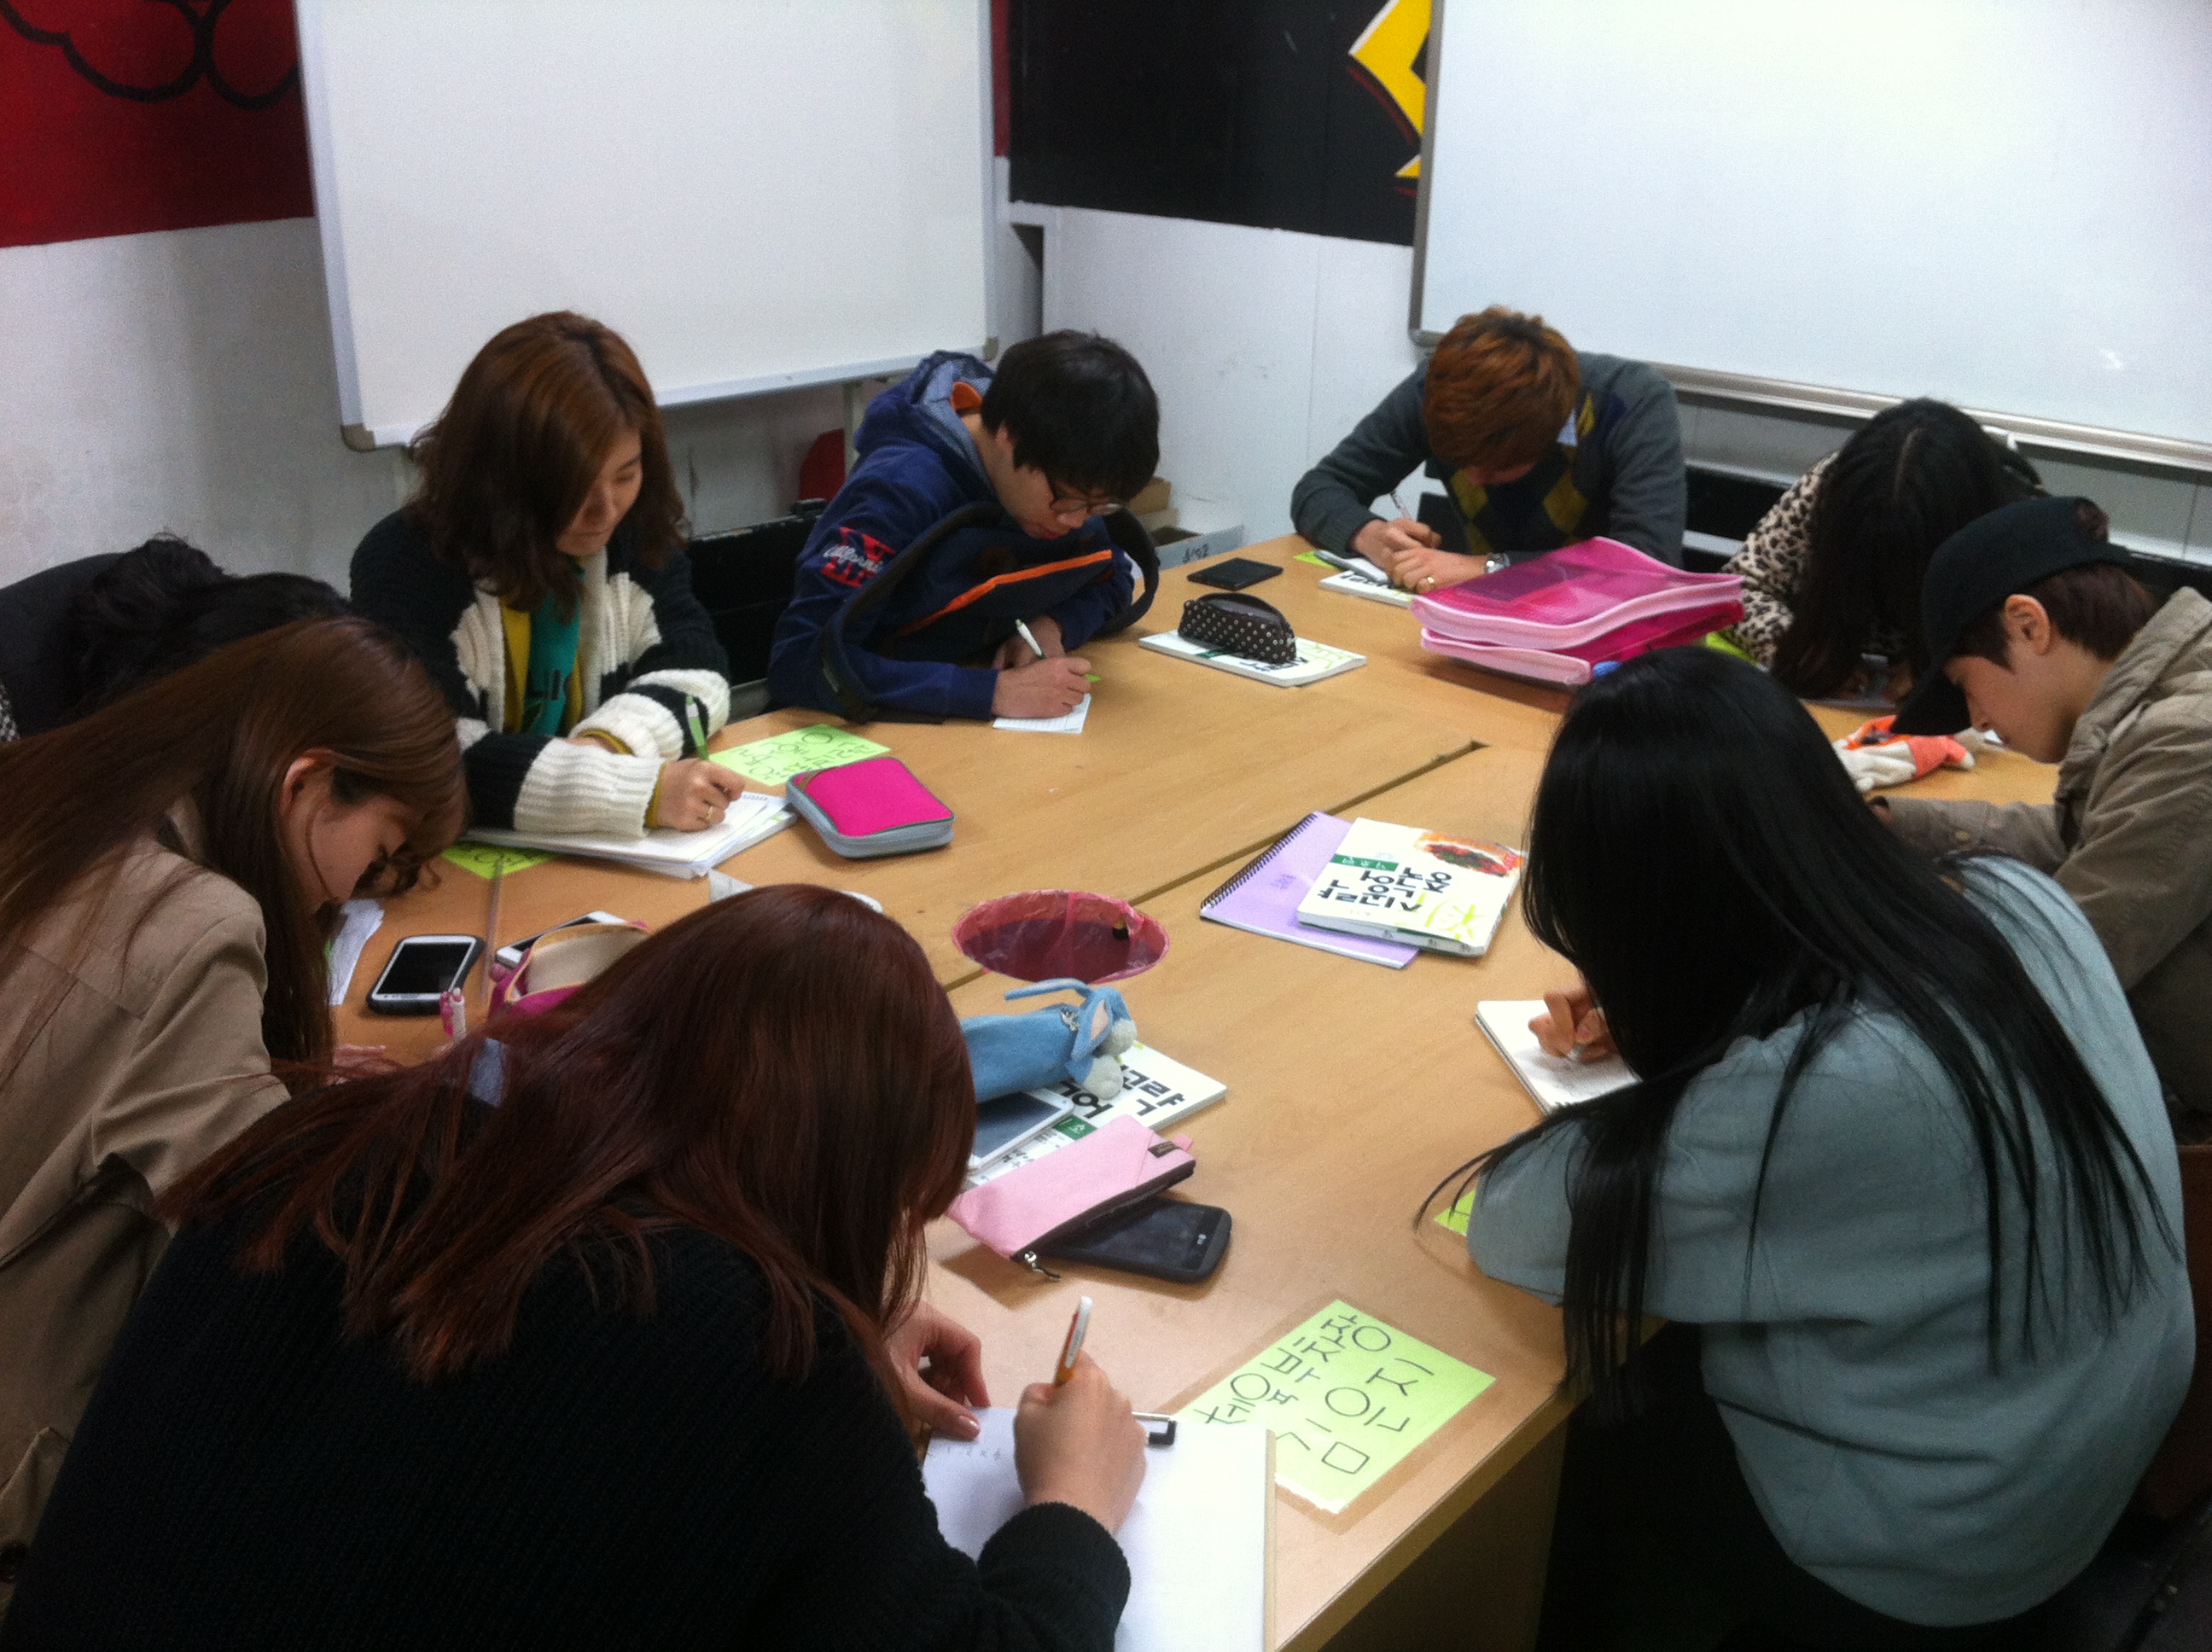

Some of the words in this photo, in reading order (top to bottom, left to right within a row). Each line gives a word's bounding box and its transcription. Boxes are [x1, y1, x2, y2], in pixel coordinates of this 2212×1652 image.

[1317, 879, 1422, 912] 신공략
[1359, 866, 1452, 899] 중국어
[1275, 1357, 1435, 1475] 김은지
